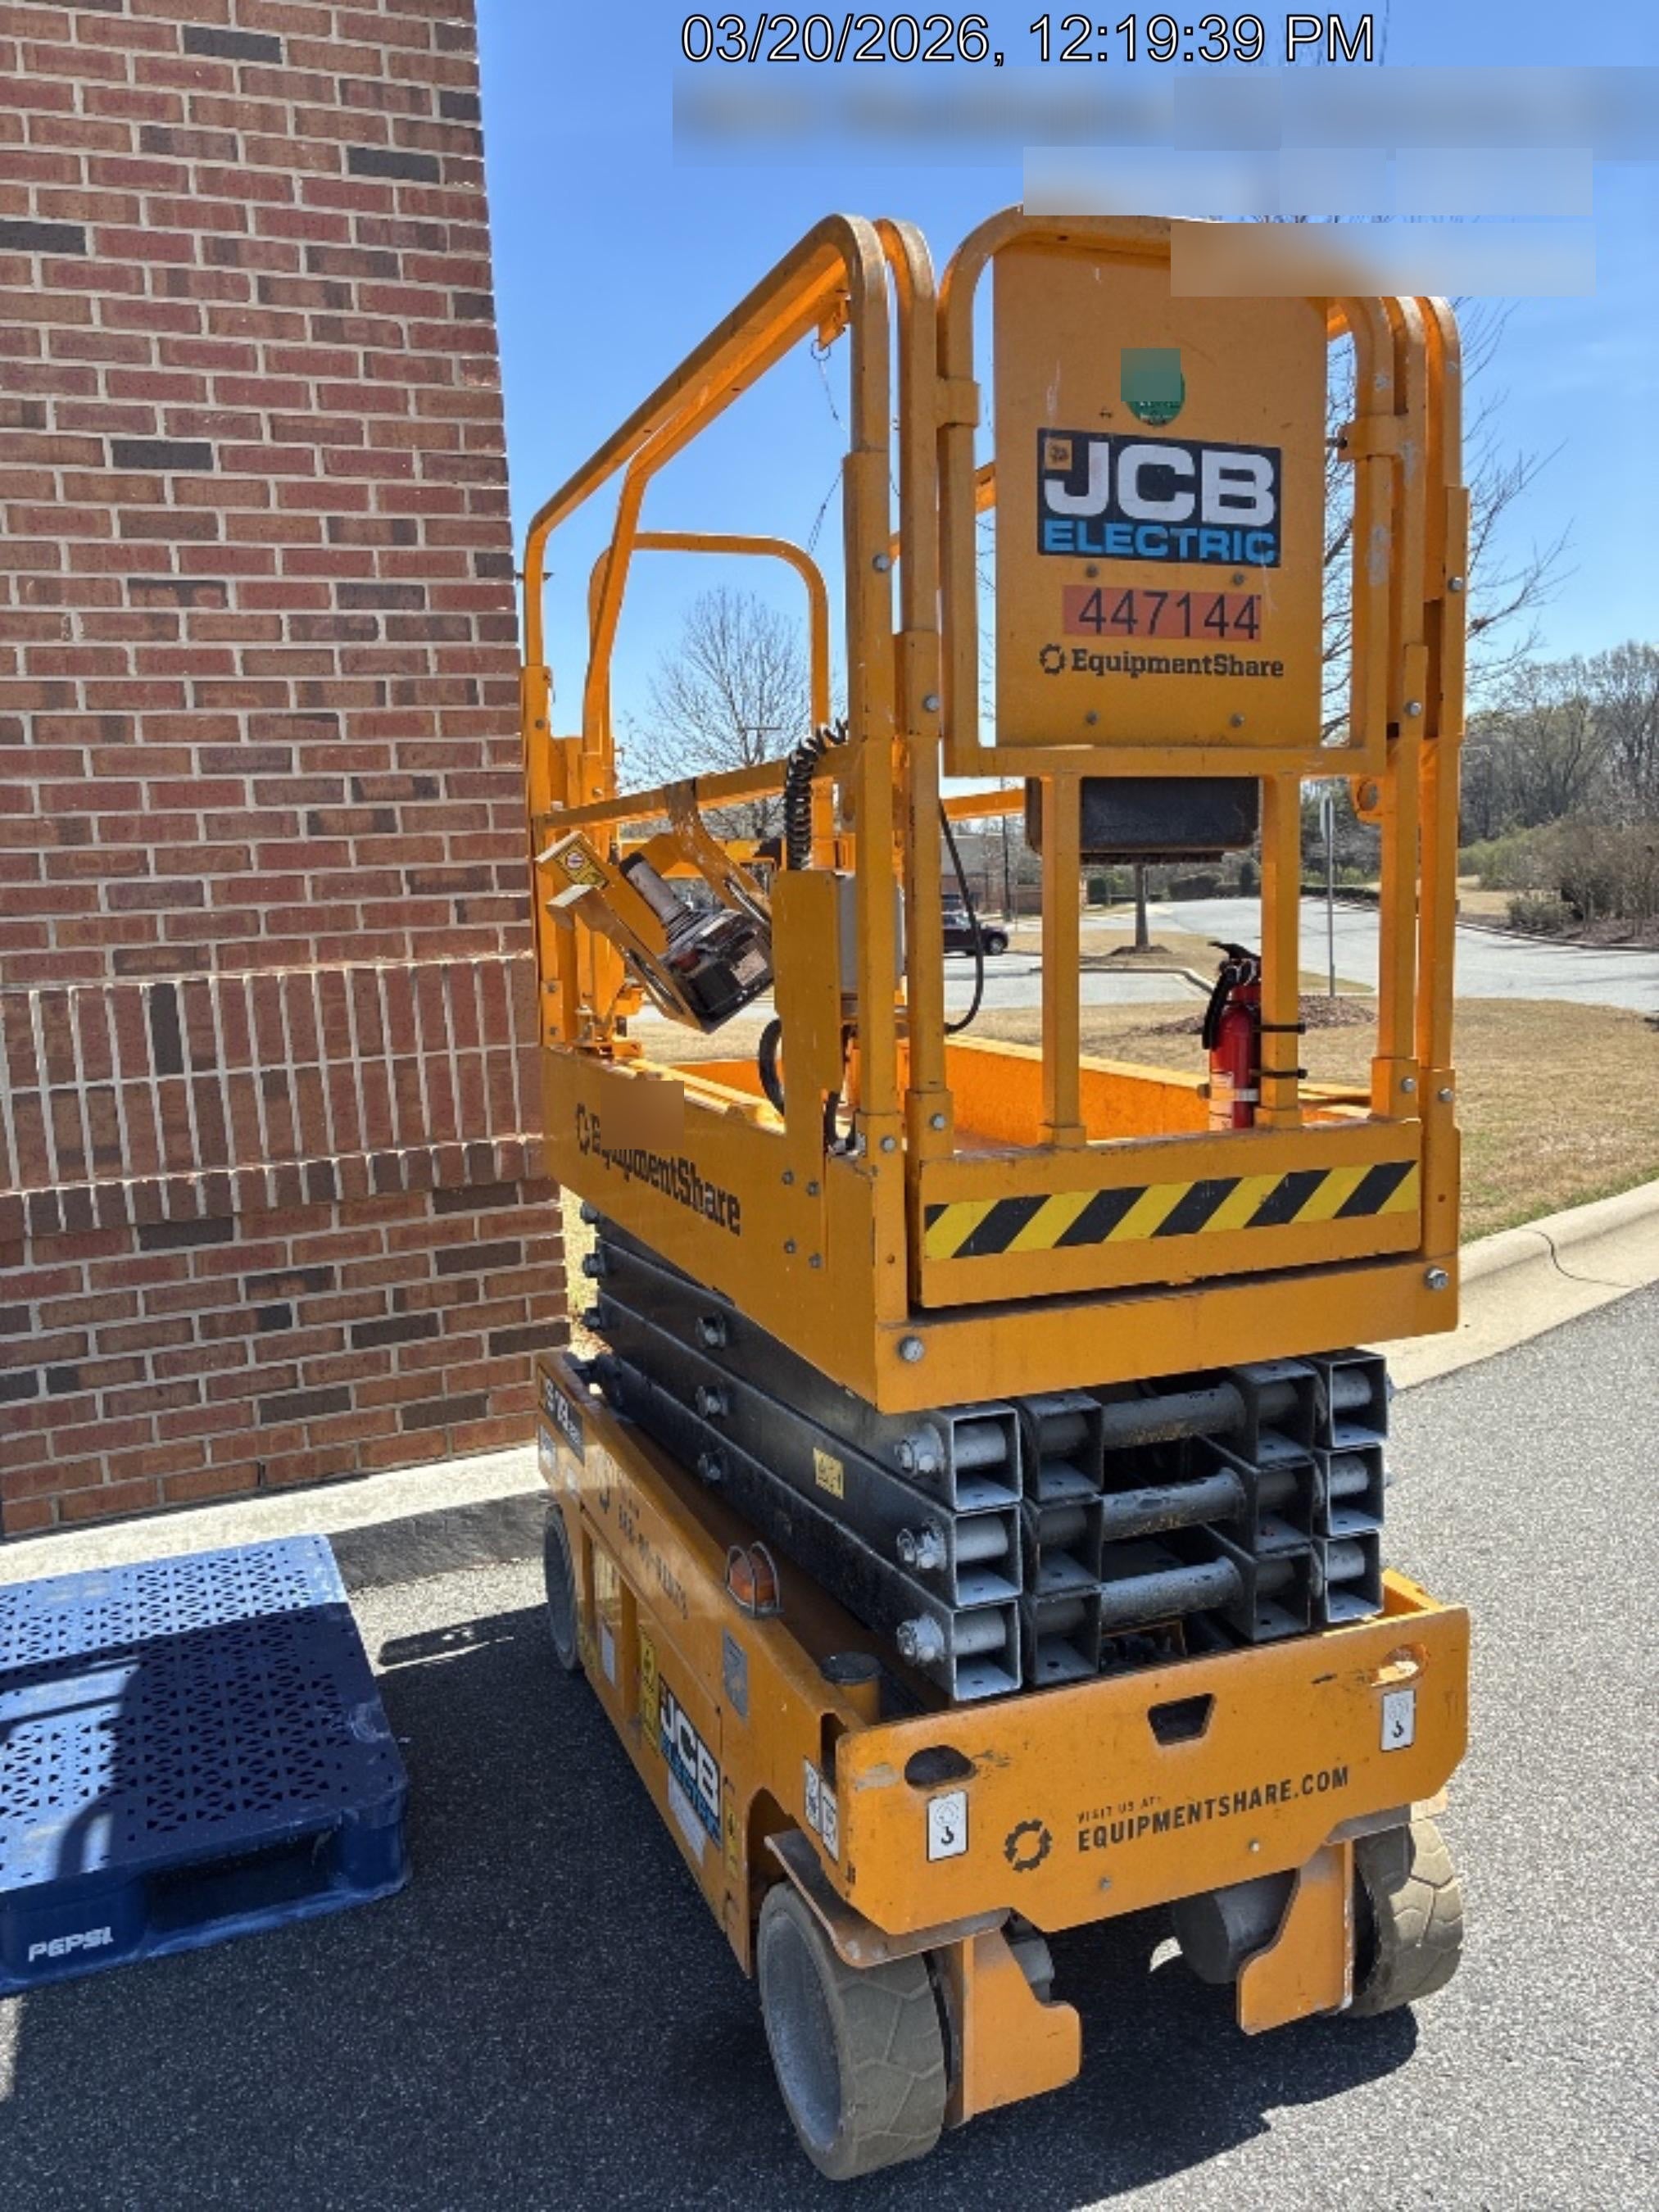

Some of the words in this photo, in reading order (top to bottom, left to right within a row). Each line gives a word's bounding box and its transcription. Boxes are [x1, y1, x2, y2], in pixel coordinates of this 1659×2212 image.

[1043, 440, 1276, 527] JCB
[1043, 519, 1276, 564] ELECTRIC
[1079, 587, 1260, 639] 447144
[1071, 649, 1284, 678] EquipmentShare
[660, 1690, 719, 1817] JCB
[1077, 1766, 1349, 1852] EQUIPMENTSHARE.COM
[1077, 1806, 1113, 1824] VISIT
[1118, 1801, 1135, 1813] US
[28, 1926, 114, 1962] PEPSI
